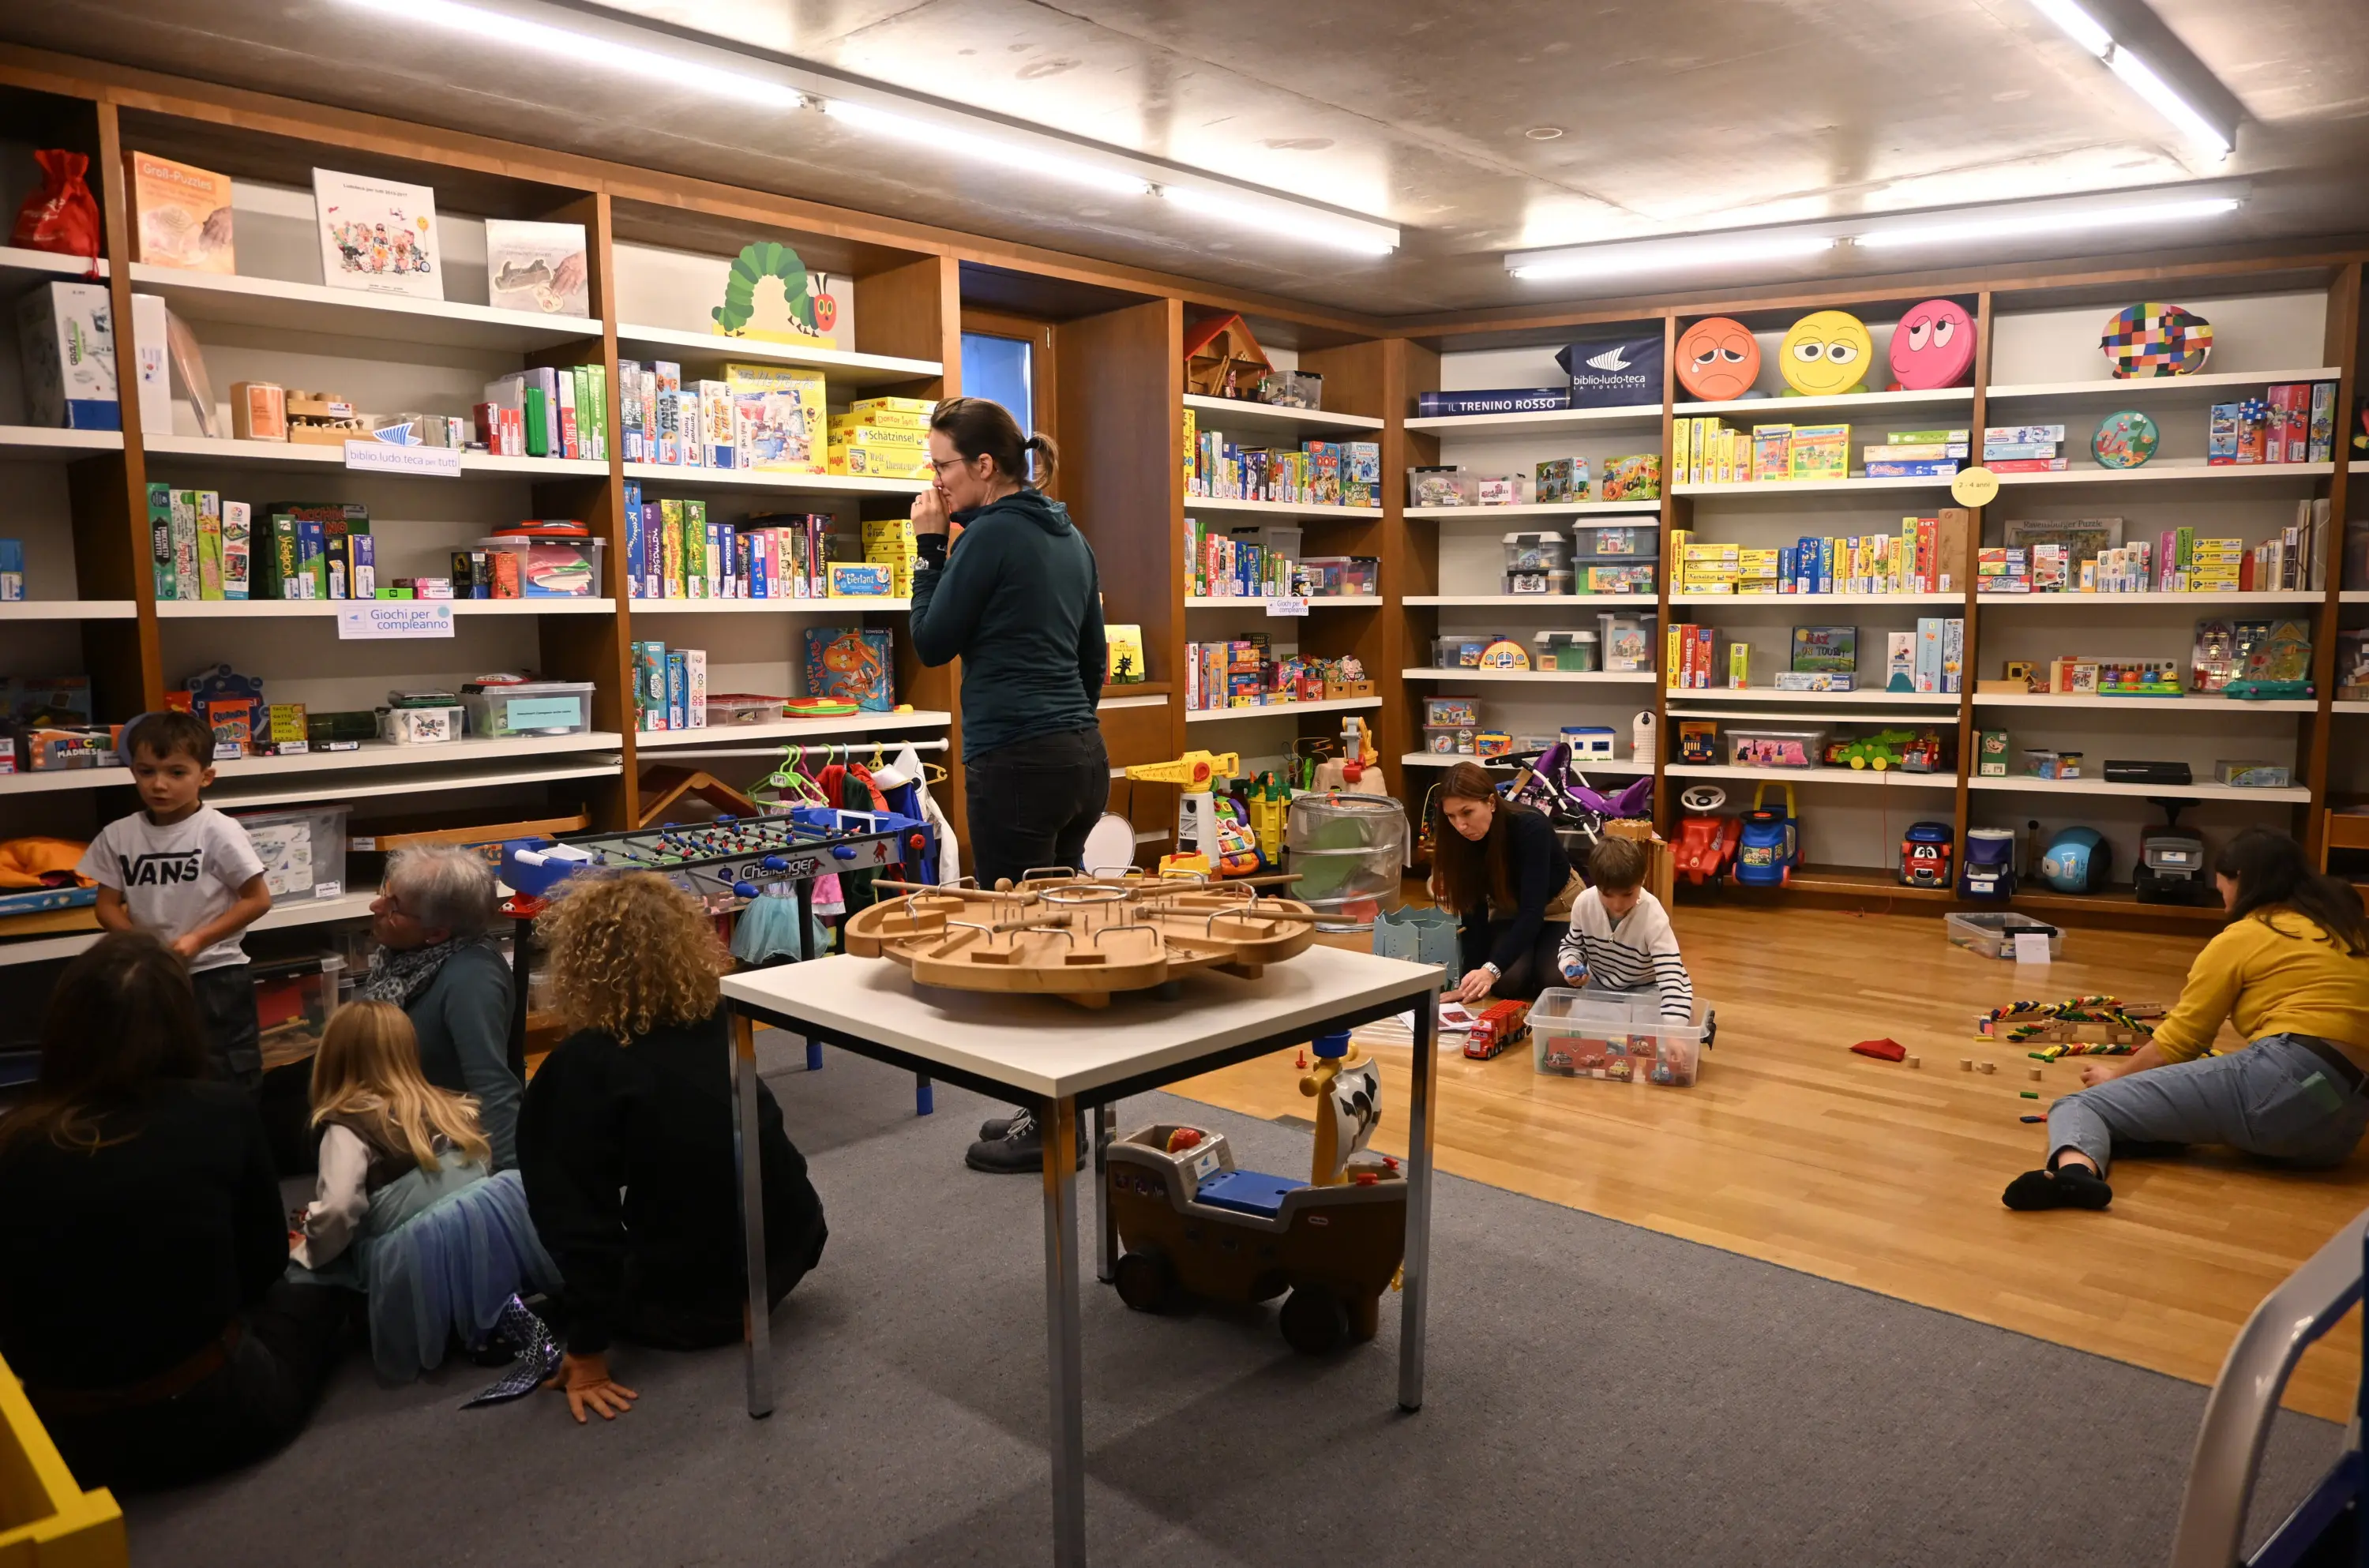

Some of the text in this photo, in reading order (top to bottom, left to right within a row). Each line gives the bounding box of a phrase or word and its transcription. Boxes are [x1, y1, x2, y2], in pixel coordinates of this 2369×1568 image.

[1447, 398, 1556, 412] IL TRENINO ROSSO
[659, 398, 670, 430] DINO
[668, 394, 679, 433] HELLO
[350, 448, 423, 466] biblio.ludo.teca
[437, 456, 458, 468] tutti
[1316, 455, 1338, 468] DOG
[2023, 519, 2103, 530] Ravensburger Puzzle
[847, 573, 874, 584] Eiertanz
[370, 610, 430, 625] Giochi per
[377, 618, 449, 632] compleanno
[54, 735, 112, 751] MATCH
[119, 848, 203, 887] VANS
